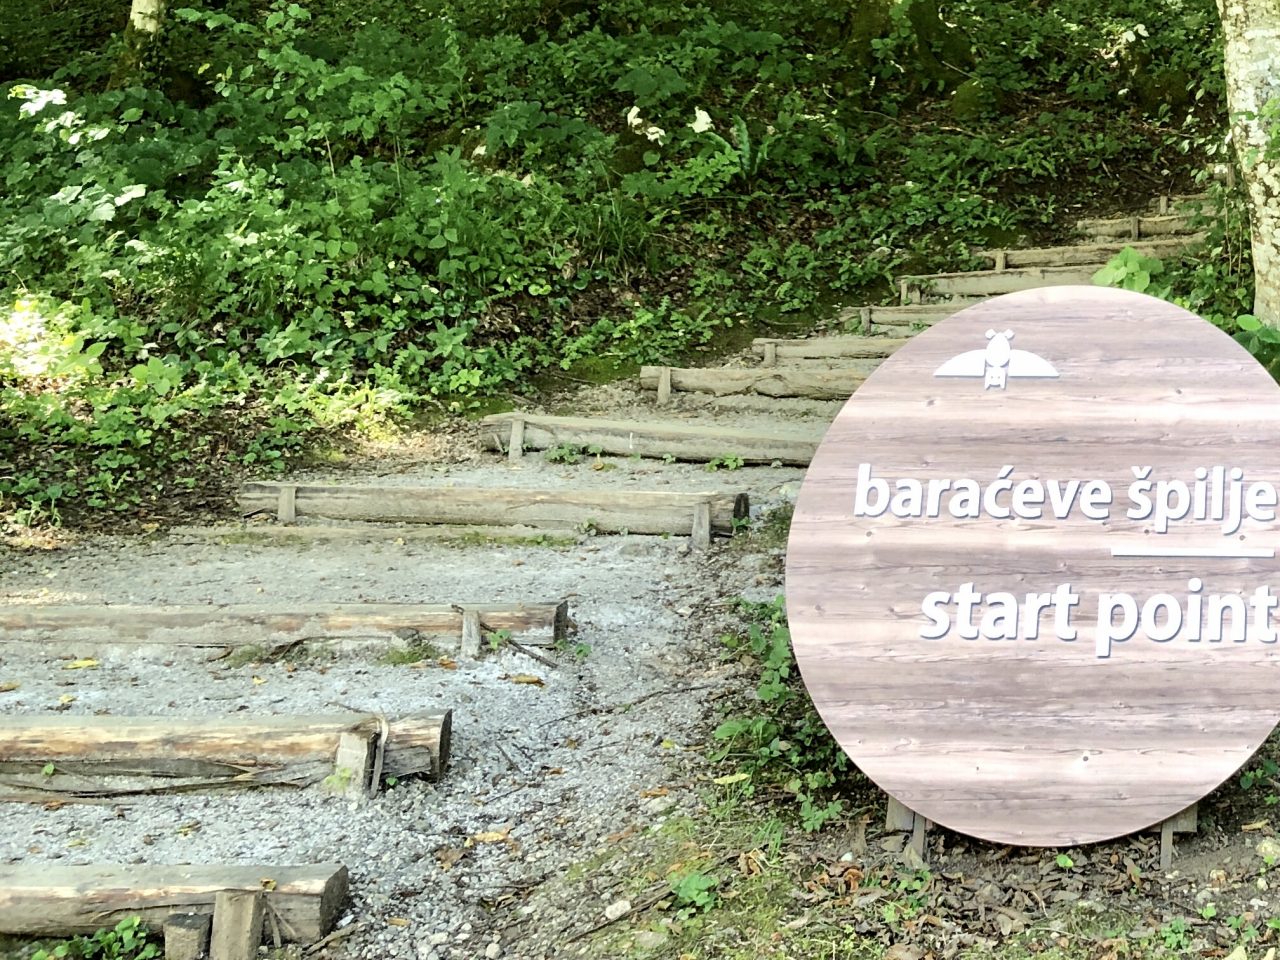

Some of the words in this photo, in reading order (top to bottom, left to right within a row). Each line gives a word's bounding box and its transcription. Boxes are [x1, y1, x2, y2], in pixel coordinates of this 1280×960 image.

[854, 464, 1112, 520] baraćeve
[1126, 466, 1278, 535] špilje
[920, 582, 1079, 641] start
[1096, 578, 1278, 658] point
